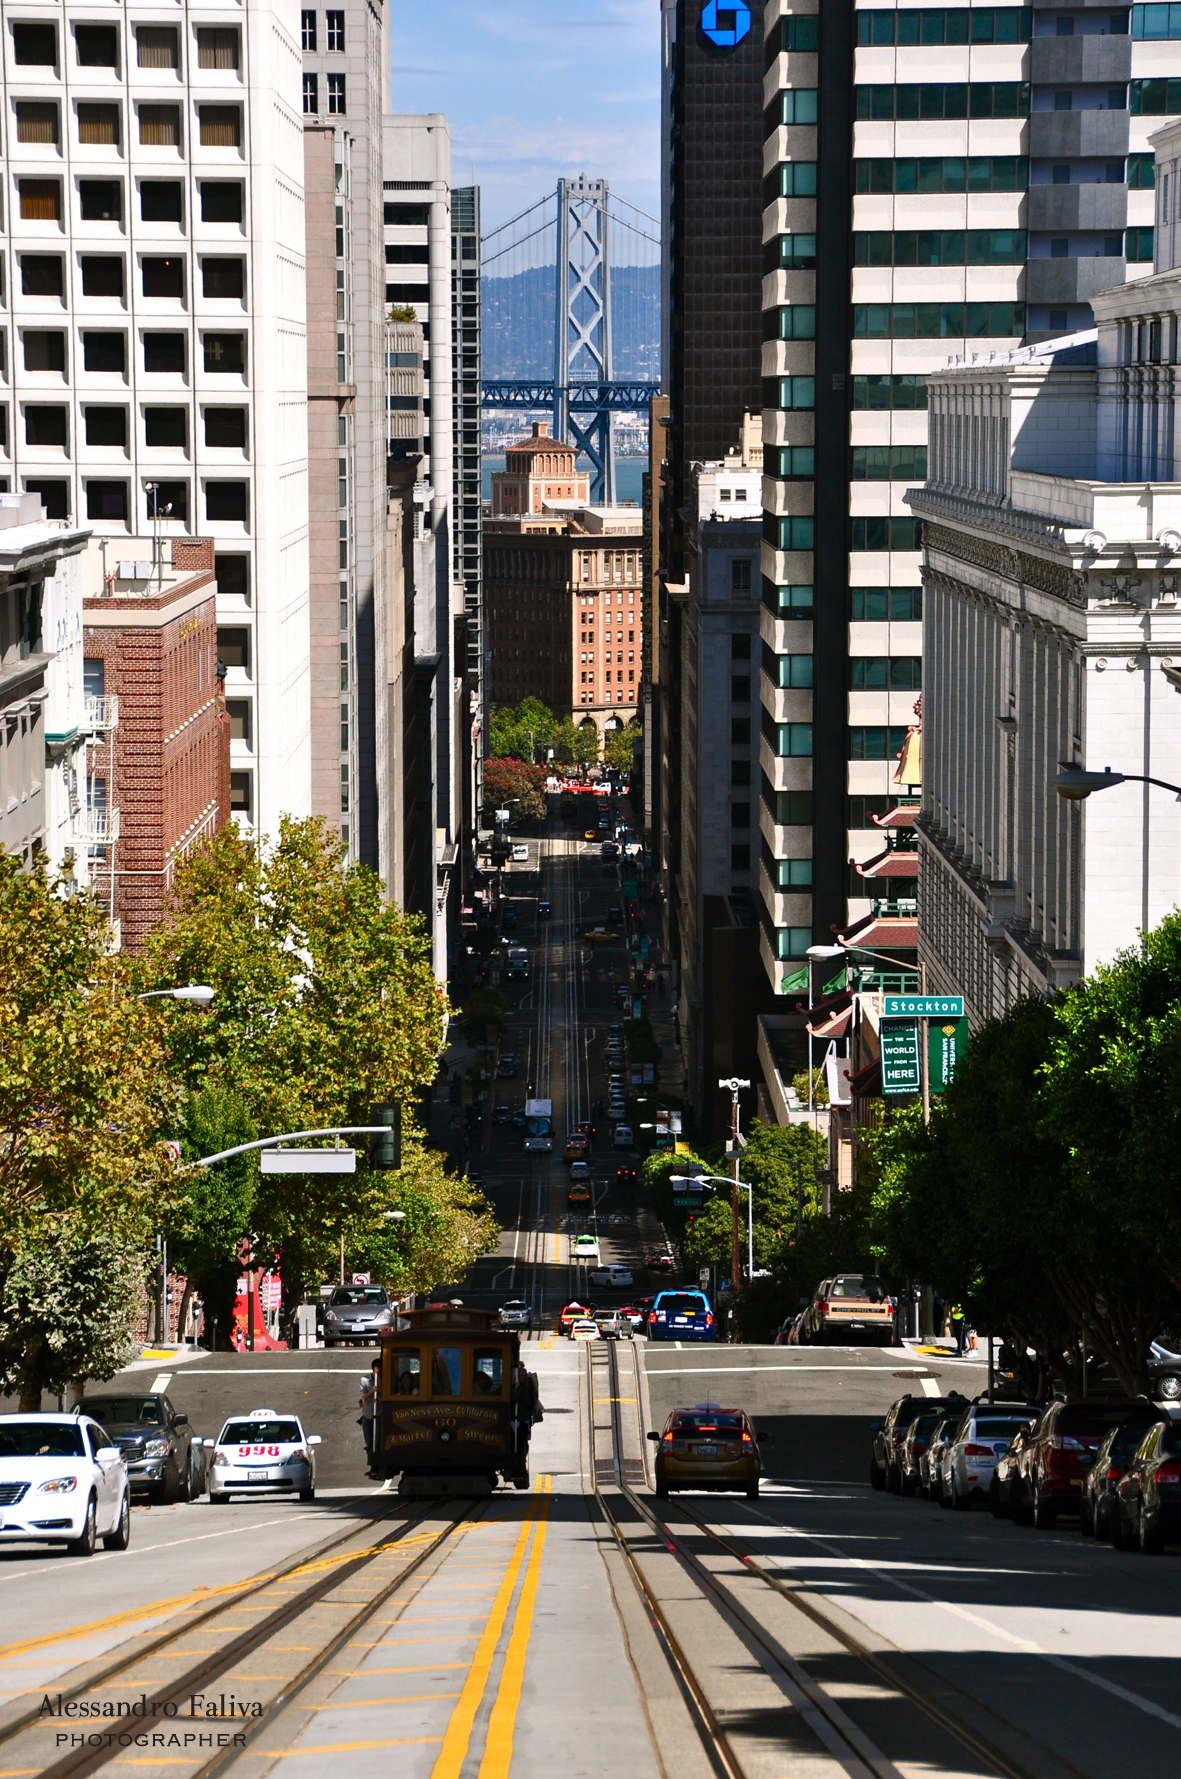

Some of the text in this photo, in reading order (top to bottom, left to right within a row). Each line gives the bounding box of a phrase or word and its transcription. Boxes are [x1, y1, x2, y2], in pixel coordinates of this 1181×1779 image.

[891, 1001, 957, 1011] Stockton
[885, 1046, 915, 1055] WORLD
[887, 1069, 915, 1079] HERE
[456, 1406, 497, 1420] California
[435, 1417, 456, 1427] 60
[398, 1431, 429, 1443] Market
[464, 1430, 499, 1443] Streets
[239, 1446, 279, 1457] 998
